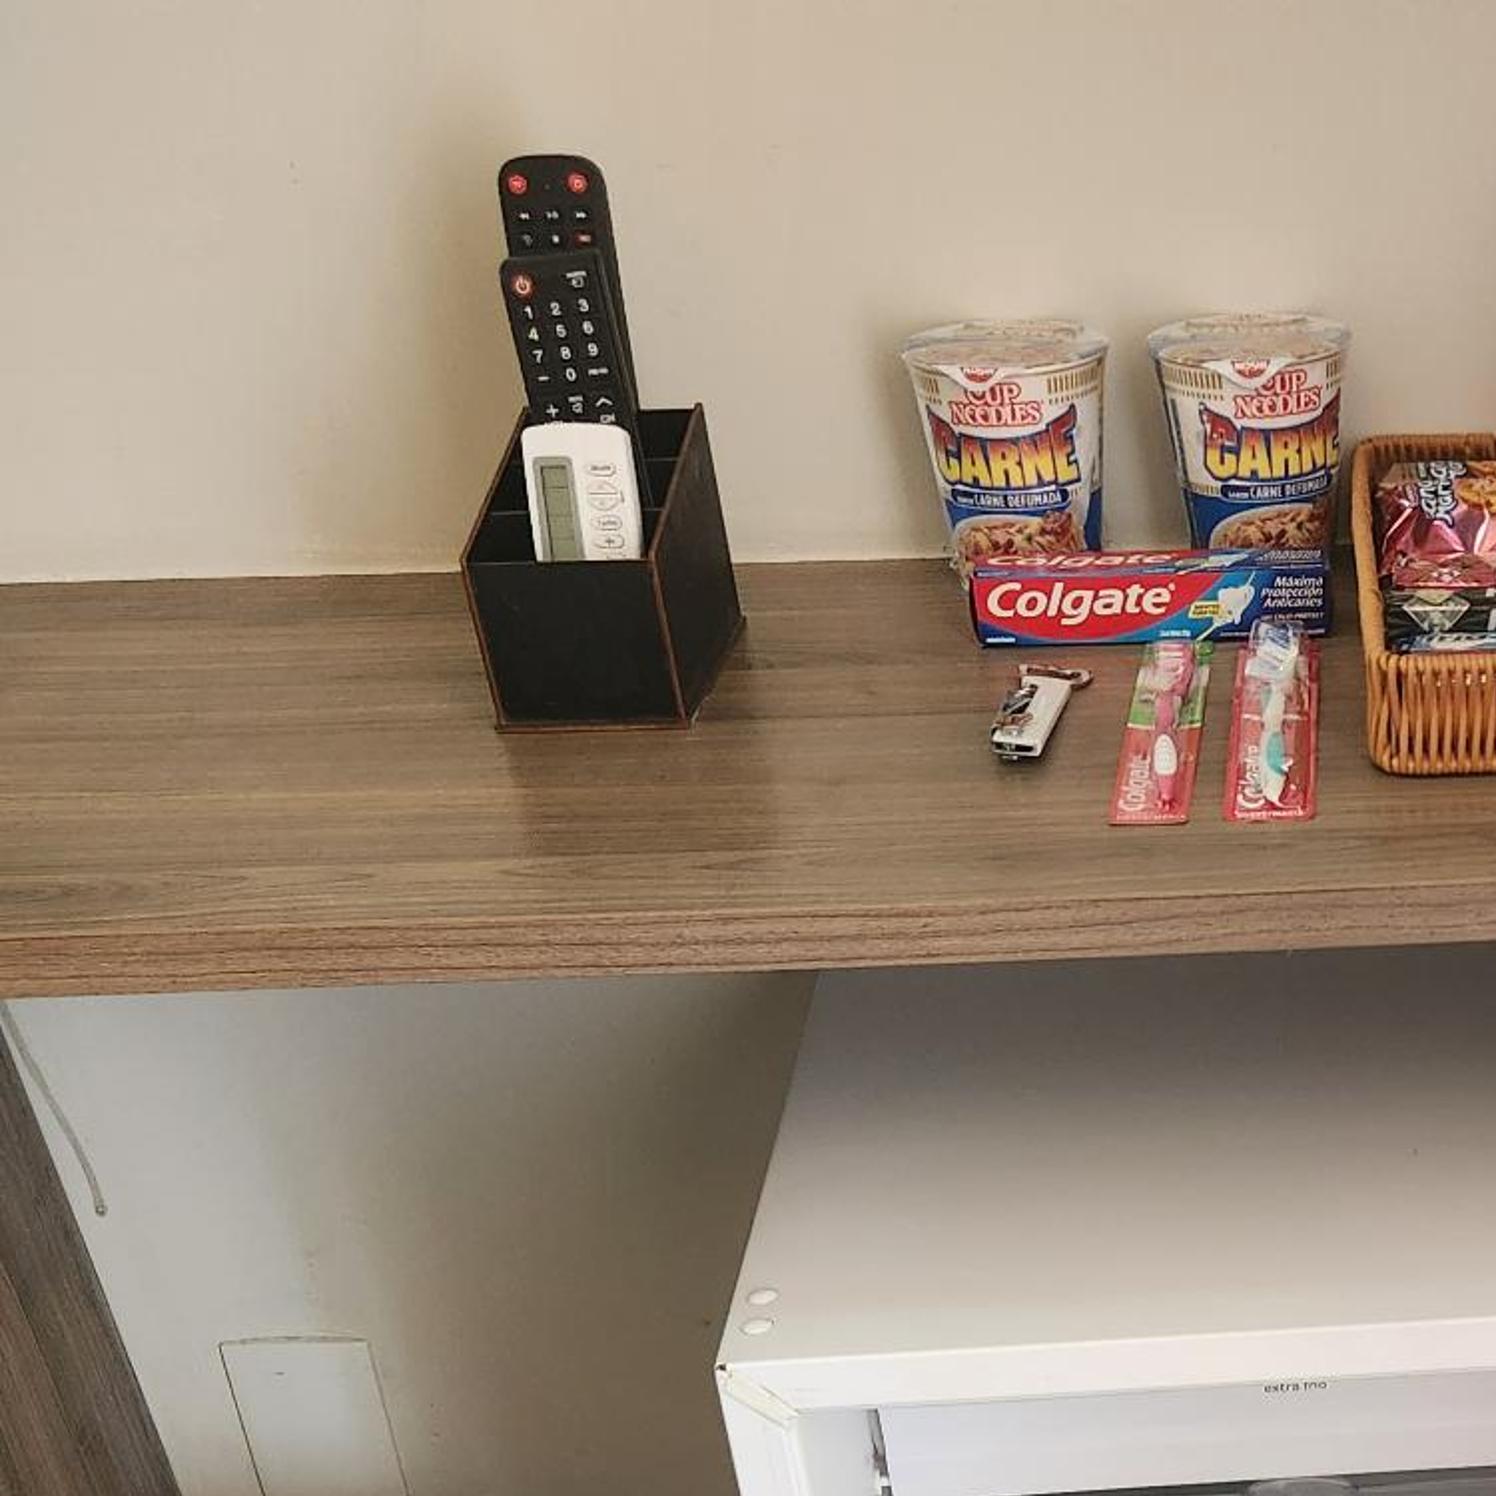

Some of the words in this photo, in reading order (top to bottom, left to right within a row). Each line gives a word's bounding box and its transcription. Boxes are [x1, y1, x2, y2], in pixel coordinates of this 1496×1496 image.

[550, 302, 561, 316] 2
[578, 299, 590, 312] 3
[528, 328, 539, 341] 4
[556, 324, 567, 337] 5
[582, 321, 594, 334] 6
[532, 350, 543, 363] 7
[560, 346, 571, 360] 8
[587, 343, 598, 356] 9
[565, 368, 577, 381] 0
[950, 401, 1044, 427] NOODLES
[1233, 387, 1322, 418] NOODLES
[1199, 388, 1341, 480] CARNE
[926, 403, 1081, 489] CARNE
[986, 582, 1173, 626] Colgate
[1263, 1382, 1300, 1393] extra
